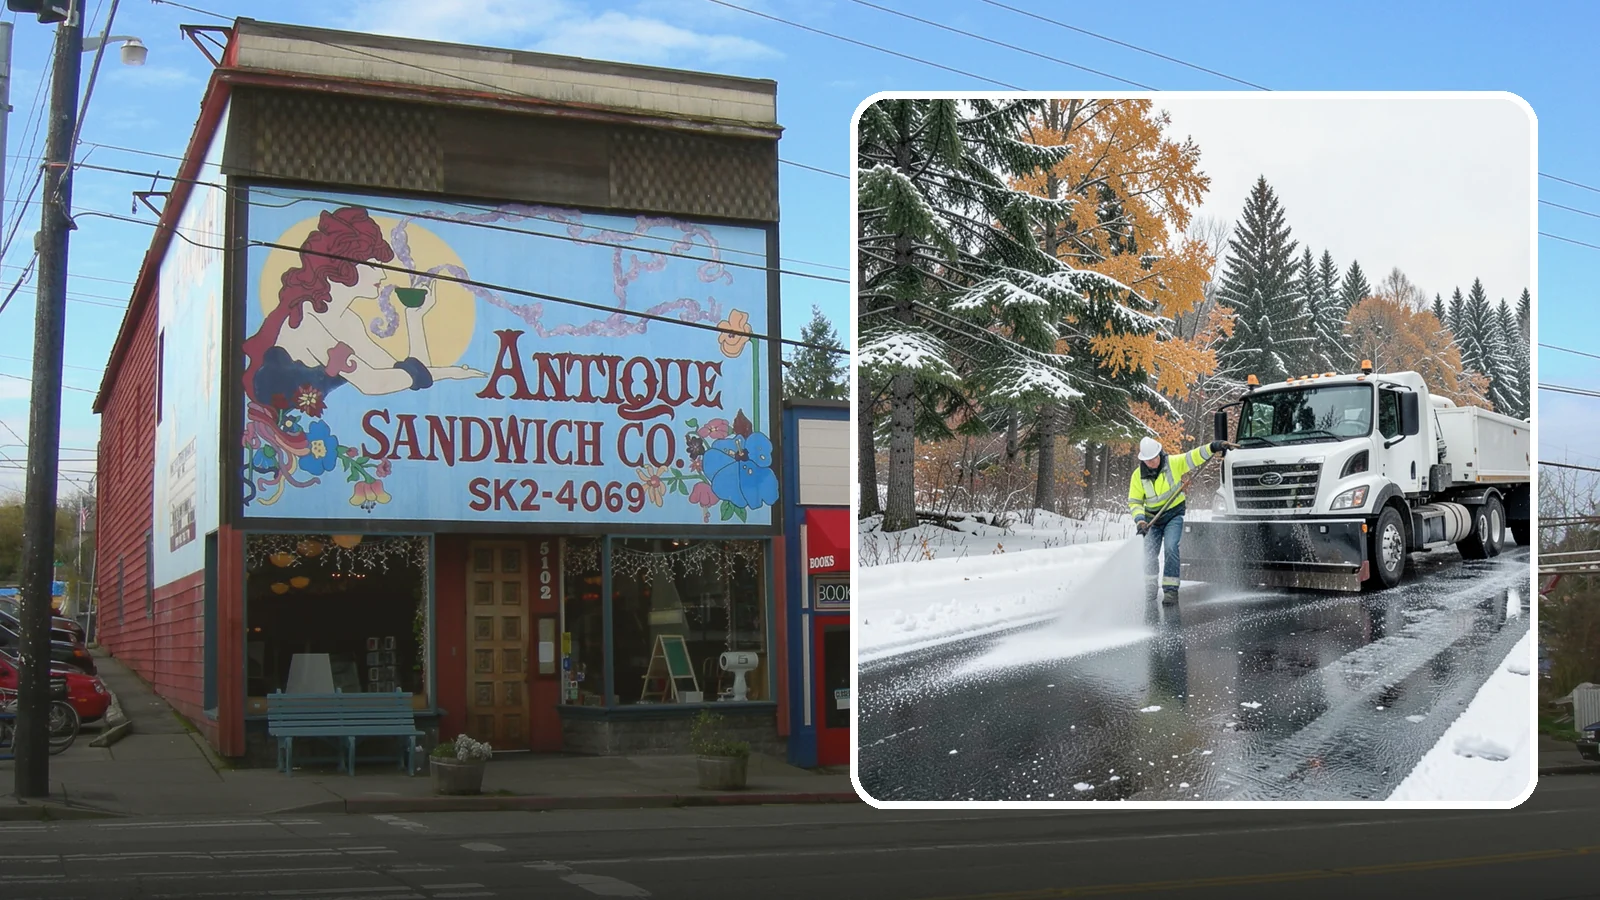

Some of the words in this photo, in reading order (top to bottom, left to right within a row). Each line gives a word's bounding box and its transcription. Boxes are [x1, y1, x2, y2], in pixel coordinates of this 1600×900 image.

[476, 329, 723, 420] ANTIQUE
[362, 408, 604, 466] SANDWICH
[617, 421, 685, 468] CO.
[468, 477, 646, 513] SK2-4069
[539, 542, 552, 600] 5102
[809, 555, 835, 569] BOOKS
